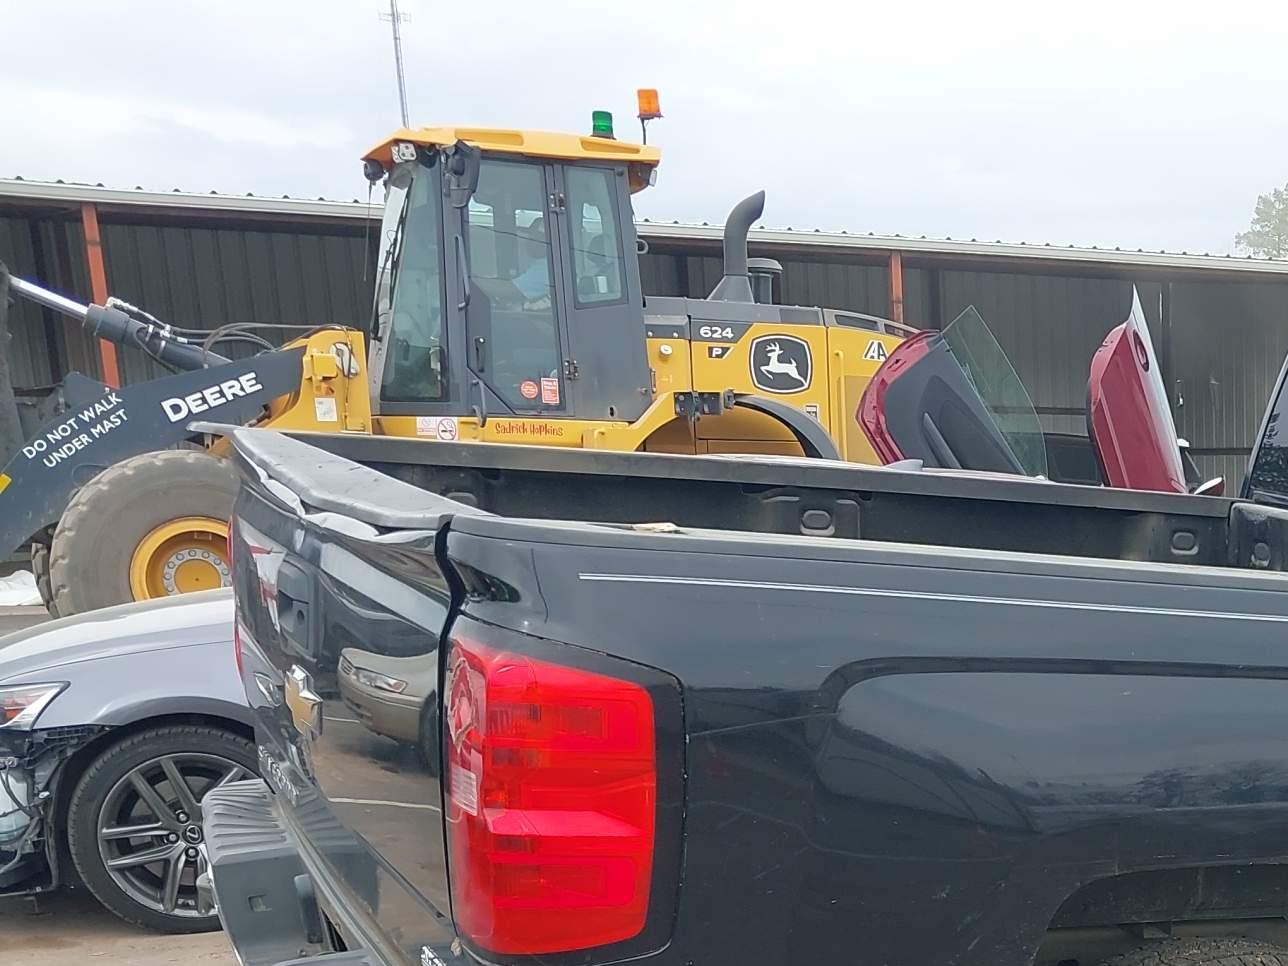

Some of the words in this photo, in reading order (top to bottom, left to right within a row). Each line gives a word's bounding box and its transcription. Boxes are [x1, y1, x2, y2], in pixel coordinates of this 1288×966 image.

[699, 326, 734, 339] 624
[711, 347, 722, 358] P
[160, 372, 263, 423] DEERE
[22, 438, 47, 460] DO
[46, 417, 80, 444] NOT
[78, 392, 123, 424] WALK
[42, 433, 93, 469] UNDER
[91, 408, 129, 439] MAST
